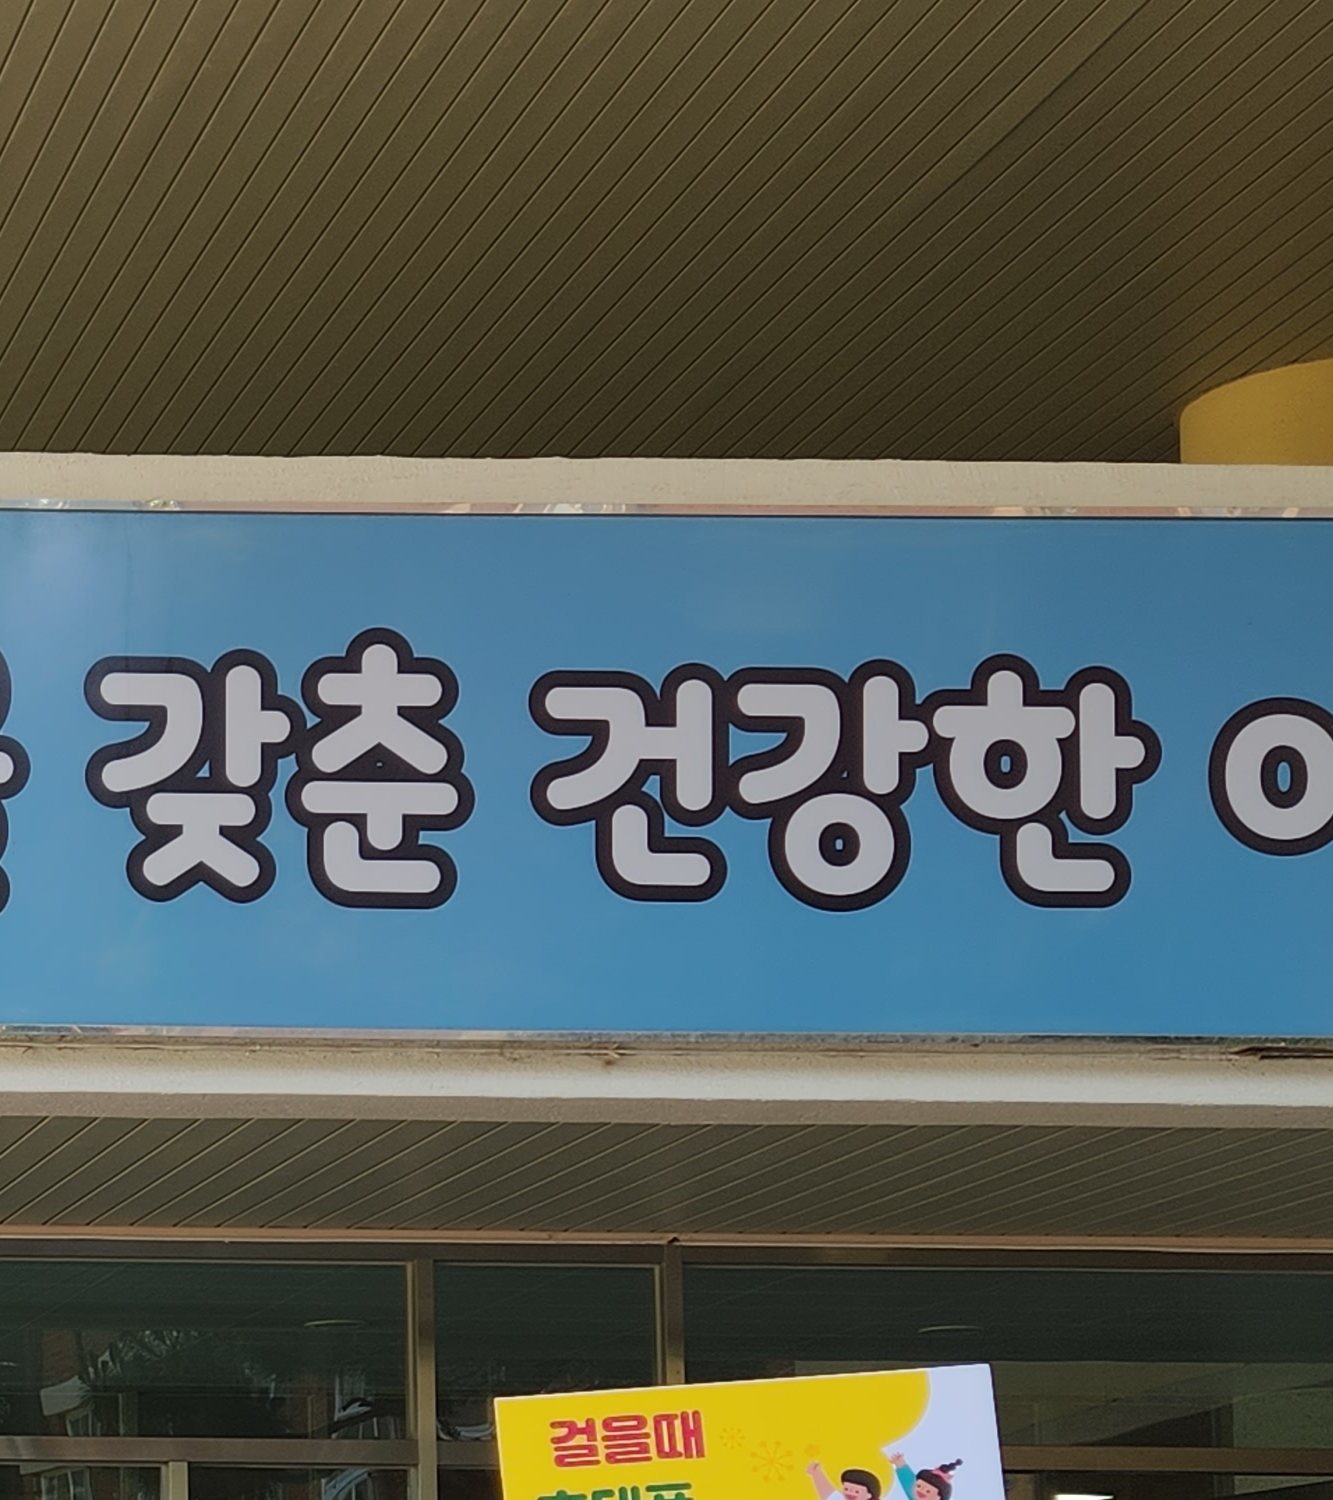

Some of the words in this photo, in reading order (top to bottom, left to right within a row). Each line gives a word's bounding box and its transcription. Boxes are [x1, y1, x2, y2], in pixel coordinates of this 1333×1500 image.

[86, 628, 471, 908] 갖춘
[530, 653, 1158, 911] 건강한
[549, 1410, 706, 1468] 걸을때
